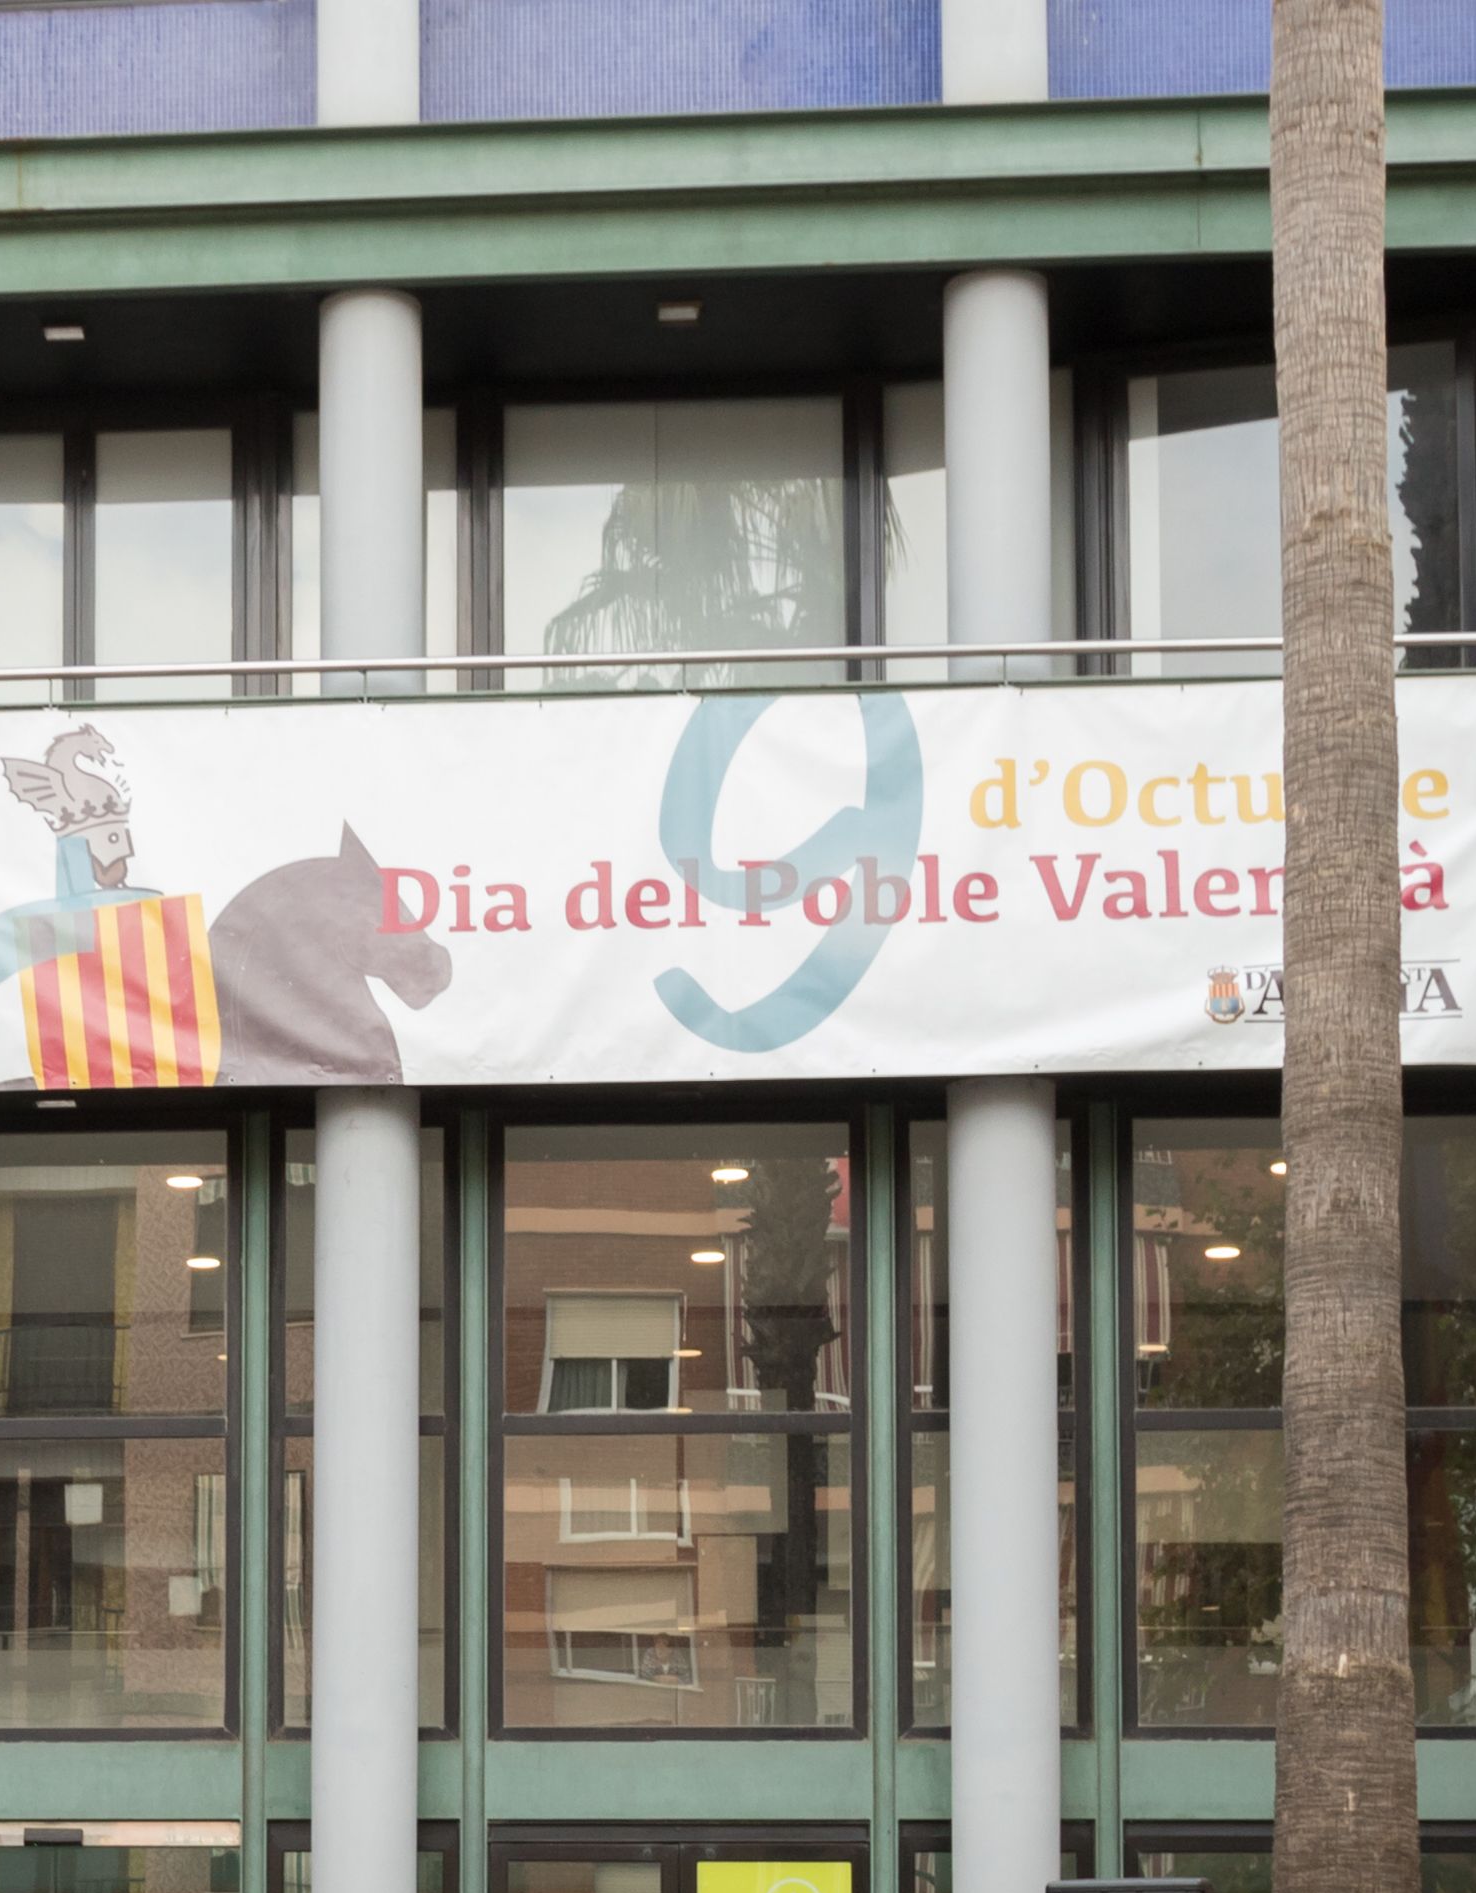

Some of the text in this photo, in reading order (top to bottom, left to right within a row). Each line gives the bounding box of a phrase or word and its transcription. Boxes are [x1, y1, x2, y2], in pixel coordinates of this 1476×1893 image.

[969, 758, 1450, 829] d'Octue
[376, 865, 533, 934] Dia
[565, 858, 707, 930] del
[737, 854, 1000, 927] Poble
